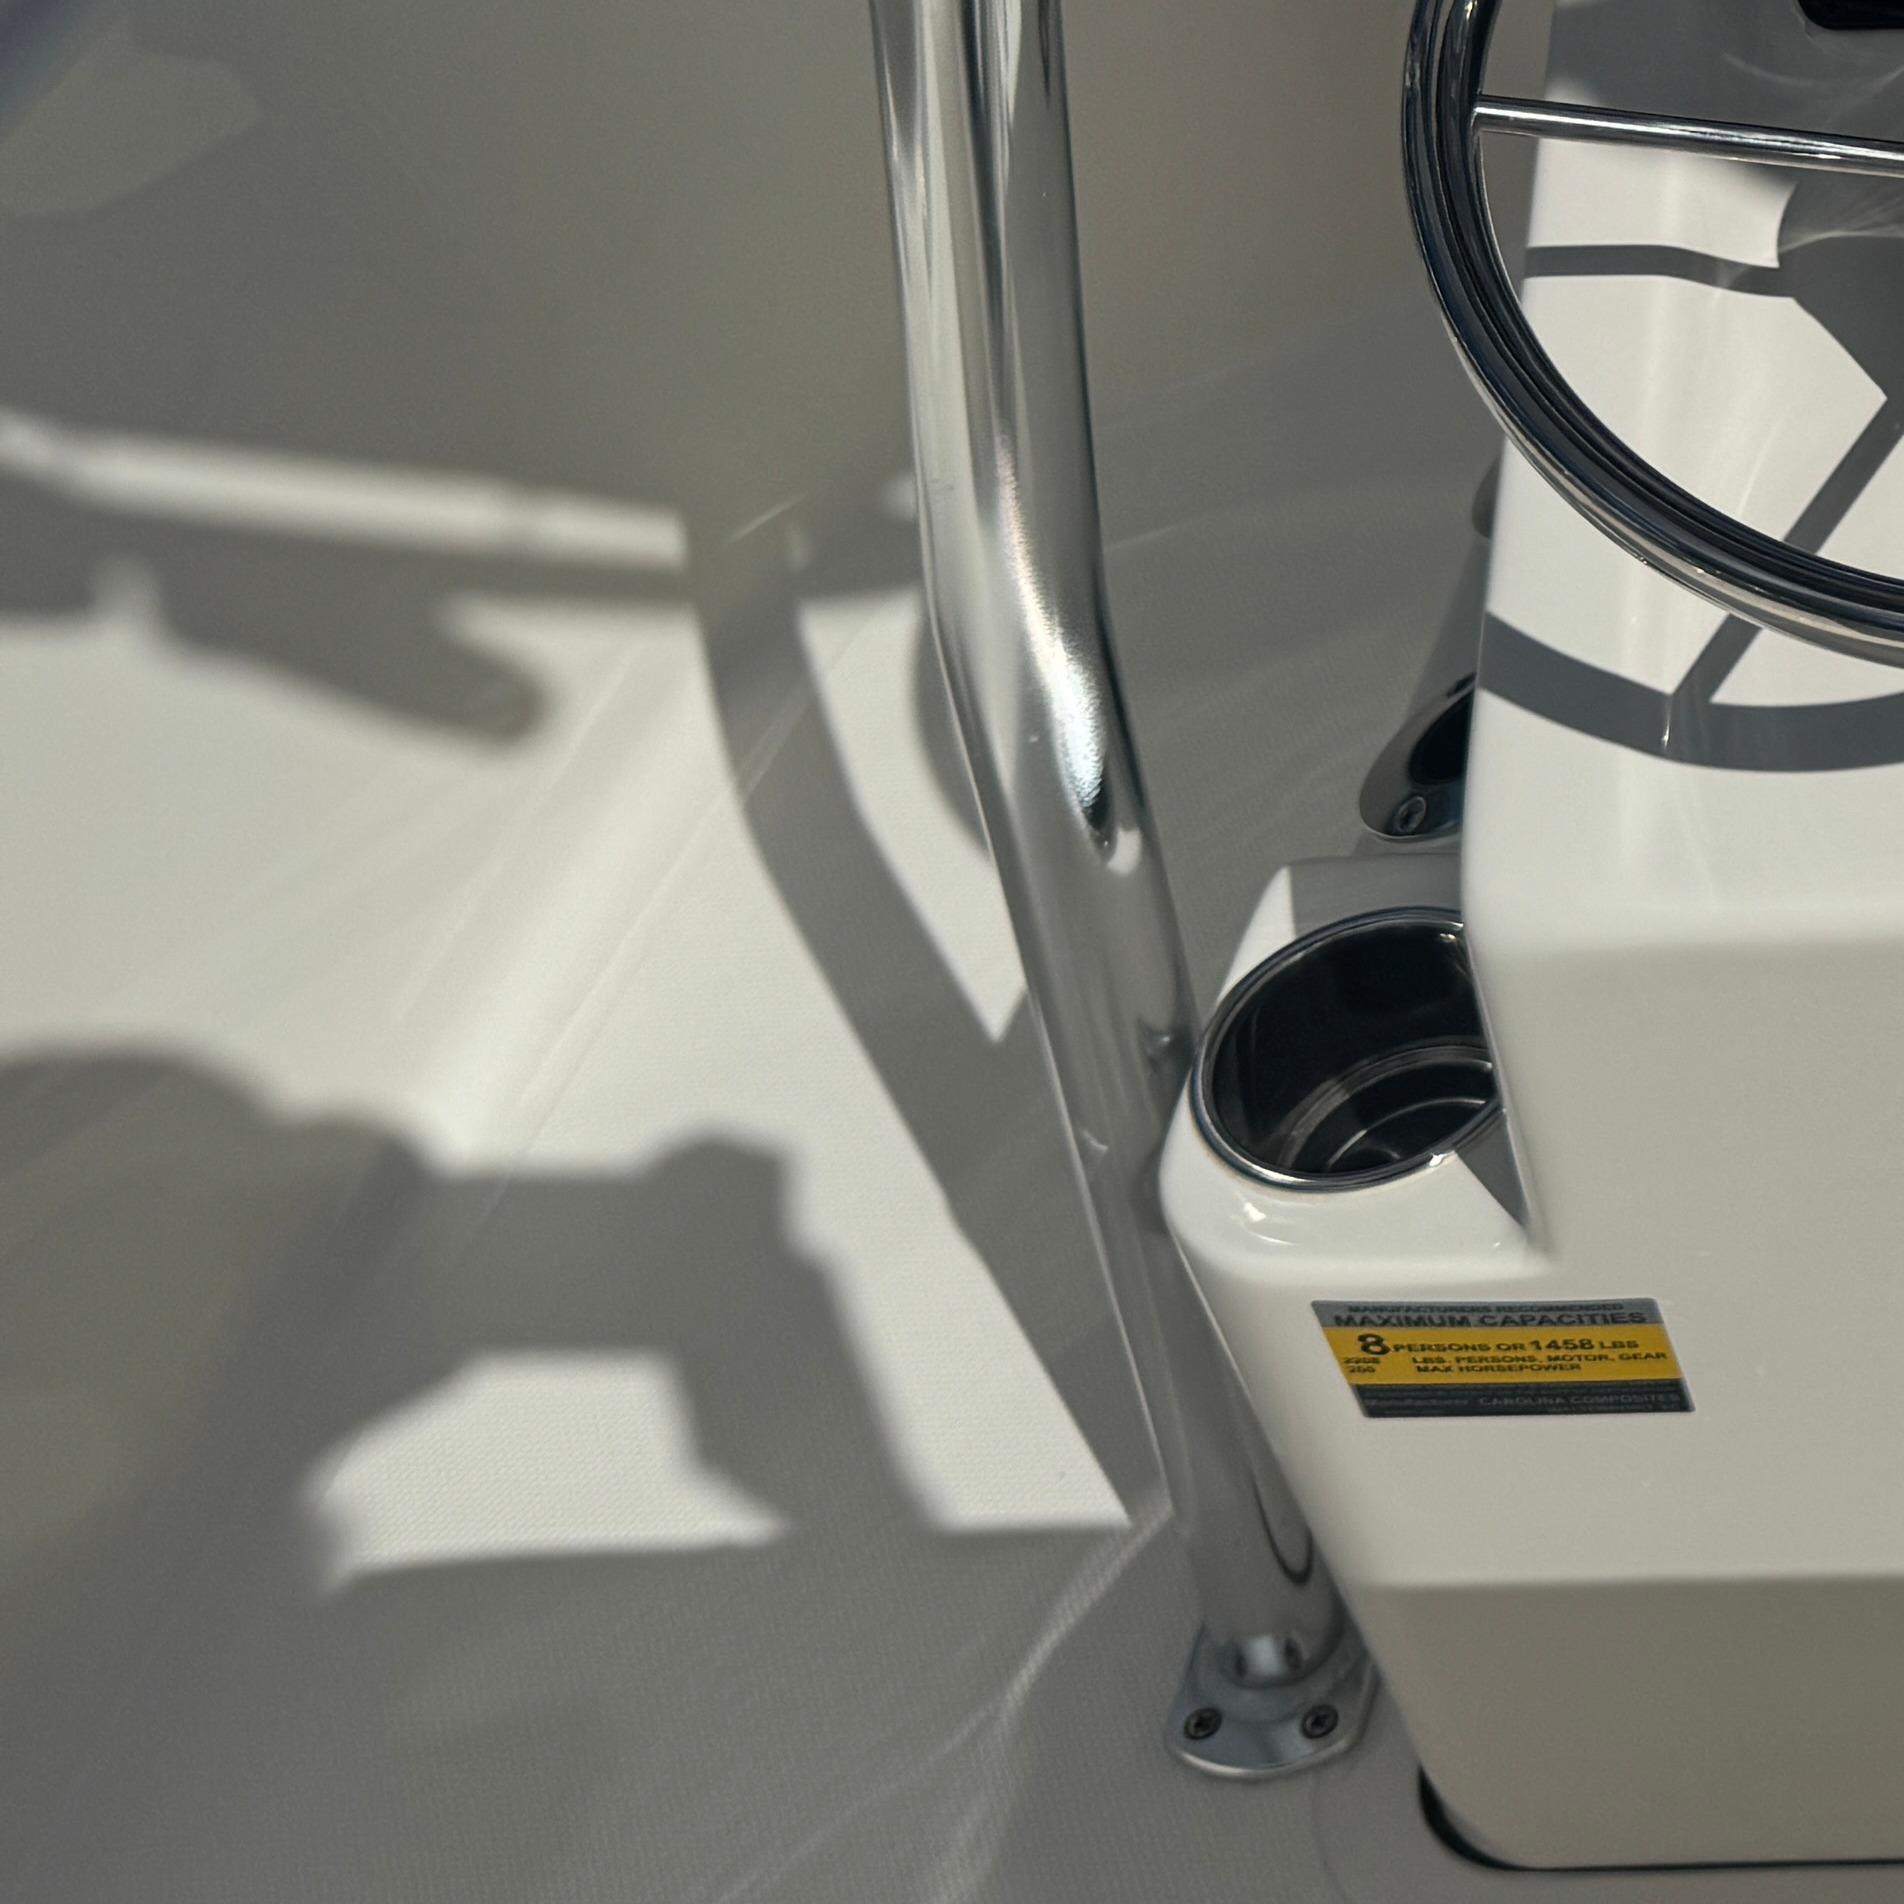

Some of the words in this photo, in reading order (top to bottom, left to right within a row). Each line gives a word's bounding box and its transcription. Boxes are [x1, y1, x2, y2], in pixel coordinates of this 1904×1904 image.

[1334, 1314, 1471, 1327] MAXIMUM
[1479, 1312, 1647, 1326] CAPACITIES
[1357, 1333, 1391, 1356] 8
[1393, 1342, 1491, 1352] PERSONS
[1496, 1342, 1525, 1351] OR
[1529, 1338, 1595, 1351] 1458
[1599, 1339, 1639, 1349] LBS
[1618, 1351, 1667, 1361] GEAR
[1458, 1362, 1582, 1373] HORSEPOWER
